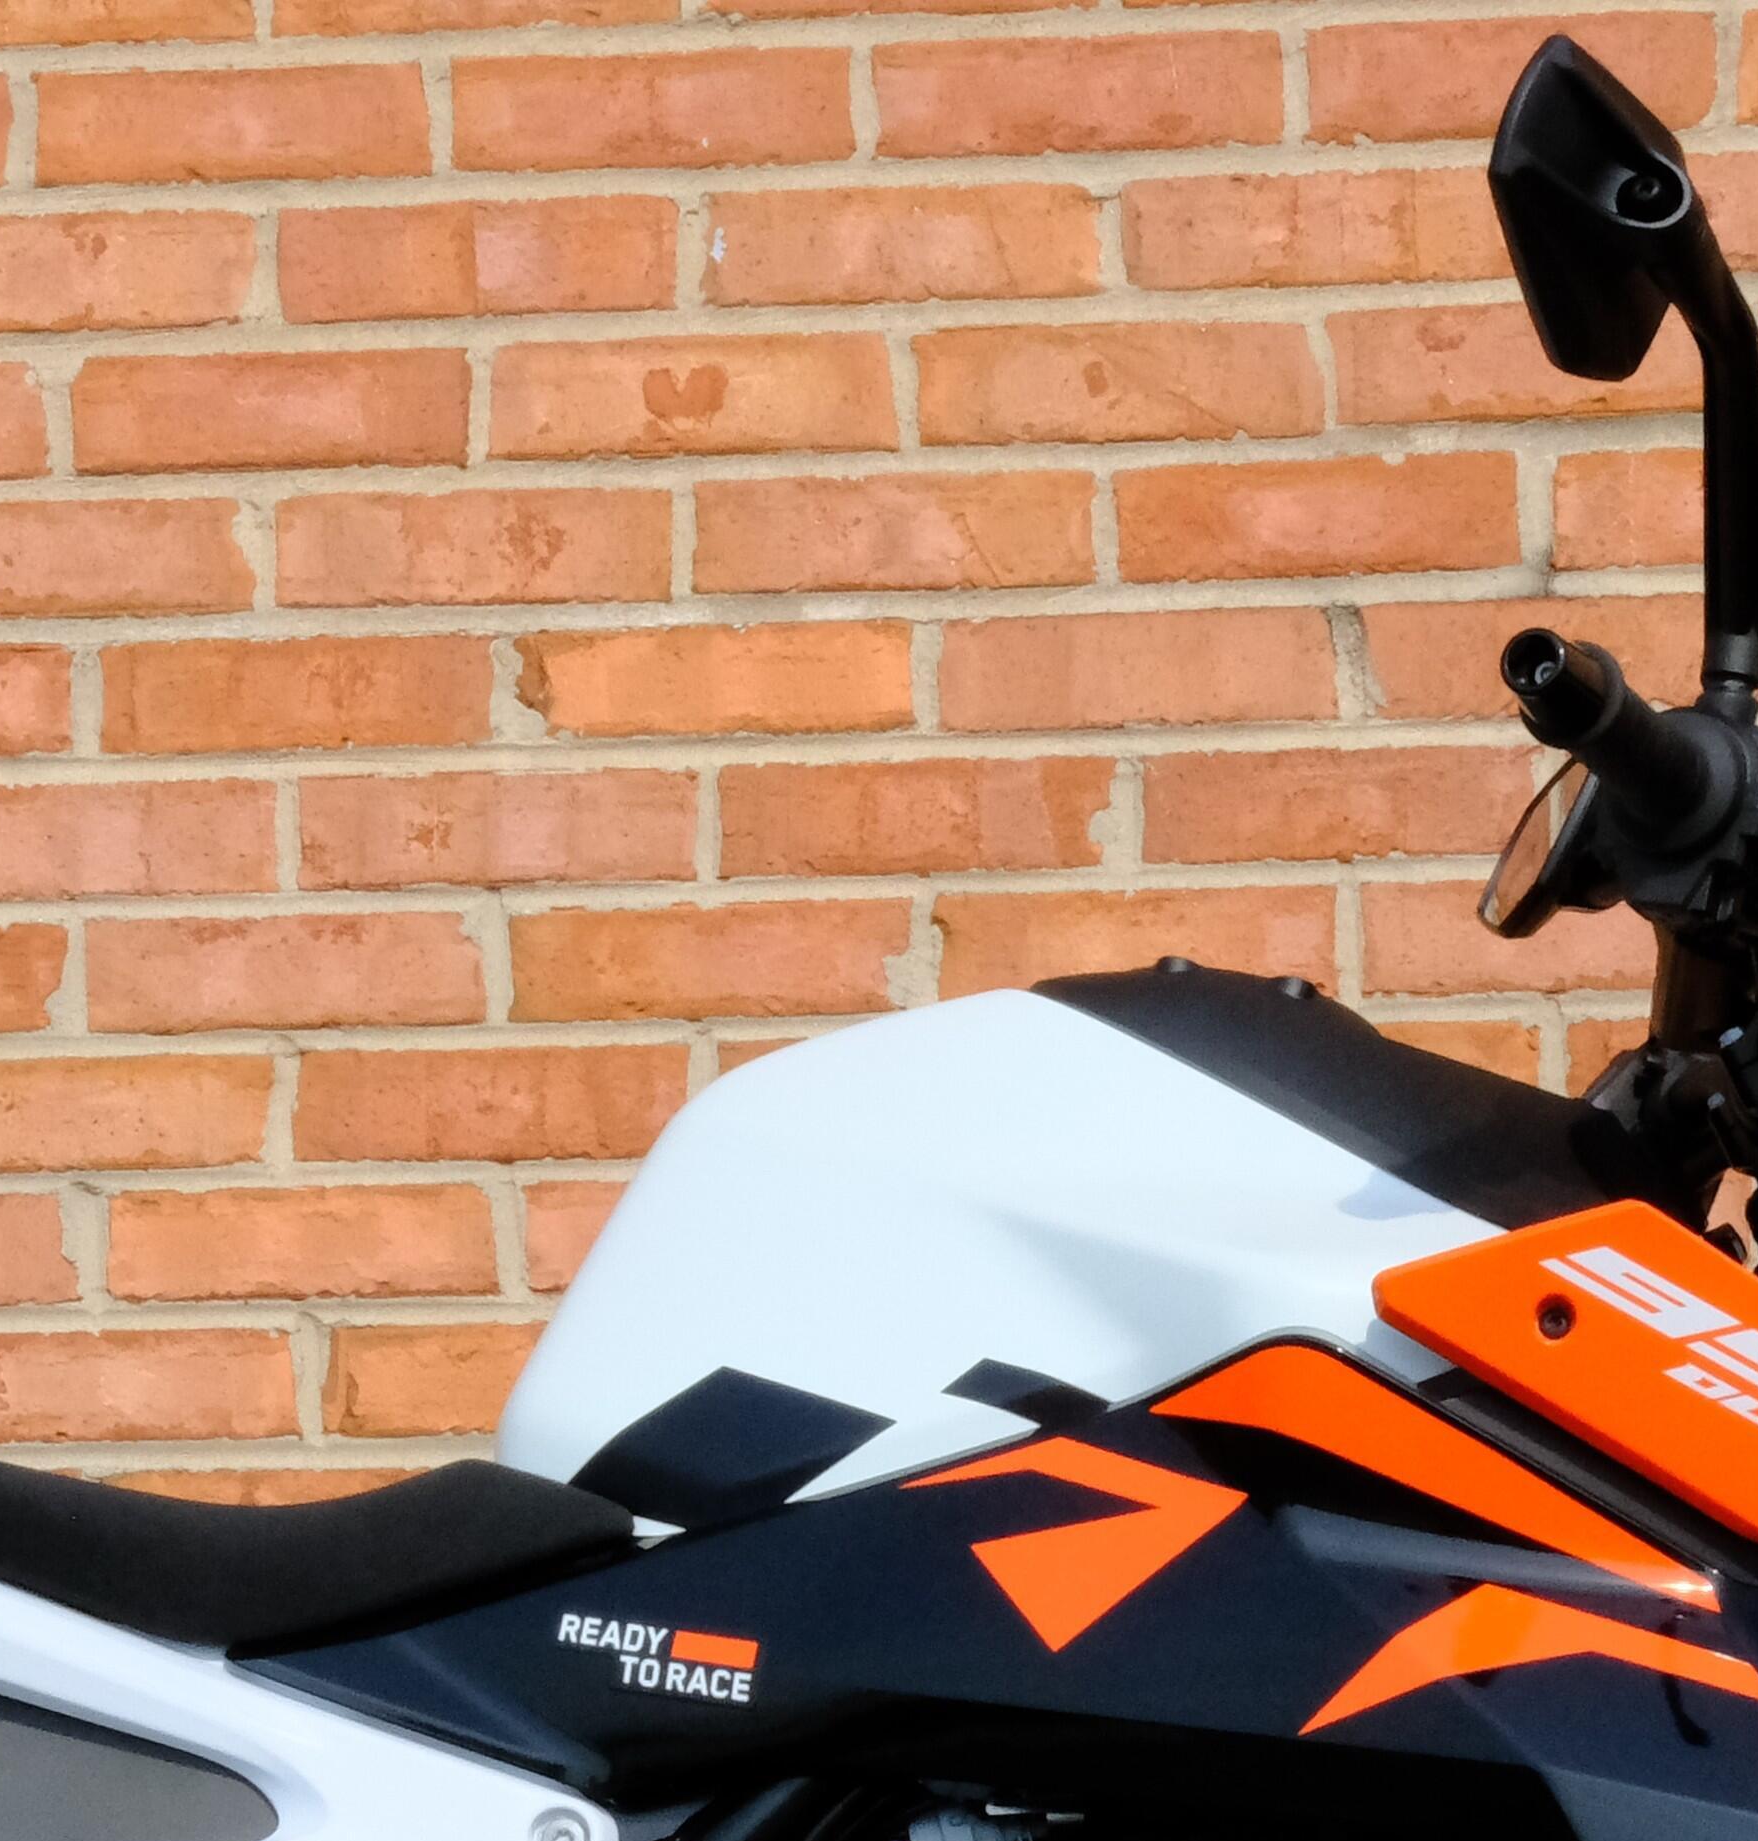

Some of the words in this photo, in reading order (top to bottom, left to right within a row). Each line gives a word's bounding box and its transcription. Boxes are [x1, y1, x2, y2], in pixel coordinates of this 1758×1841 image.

[557, 1612, 669, 1656] READY
[618, 1653, 661, 1689] TO
[664, 1661, 753, 1703] RACE
